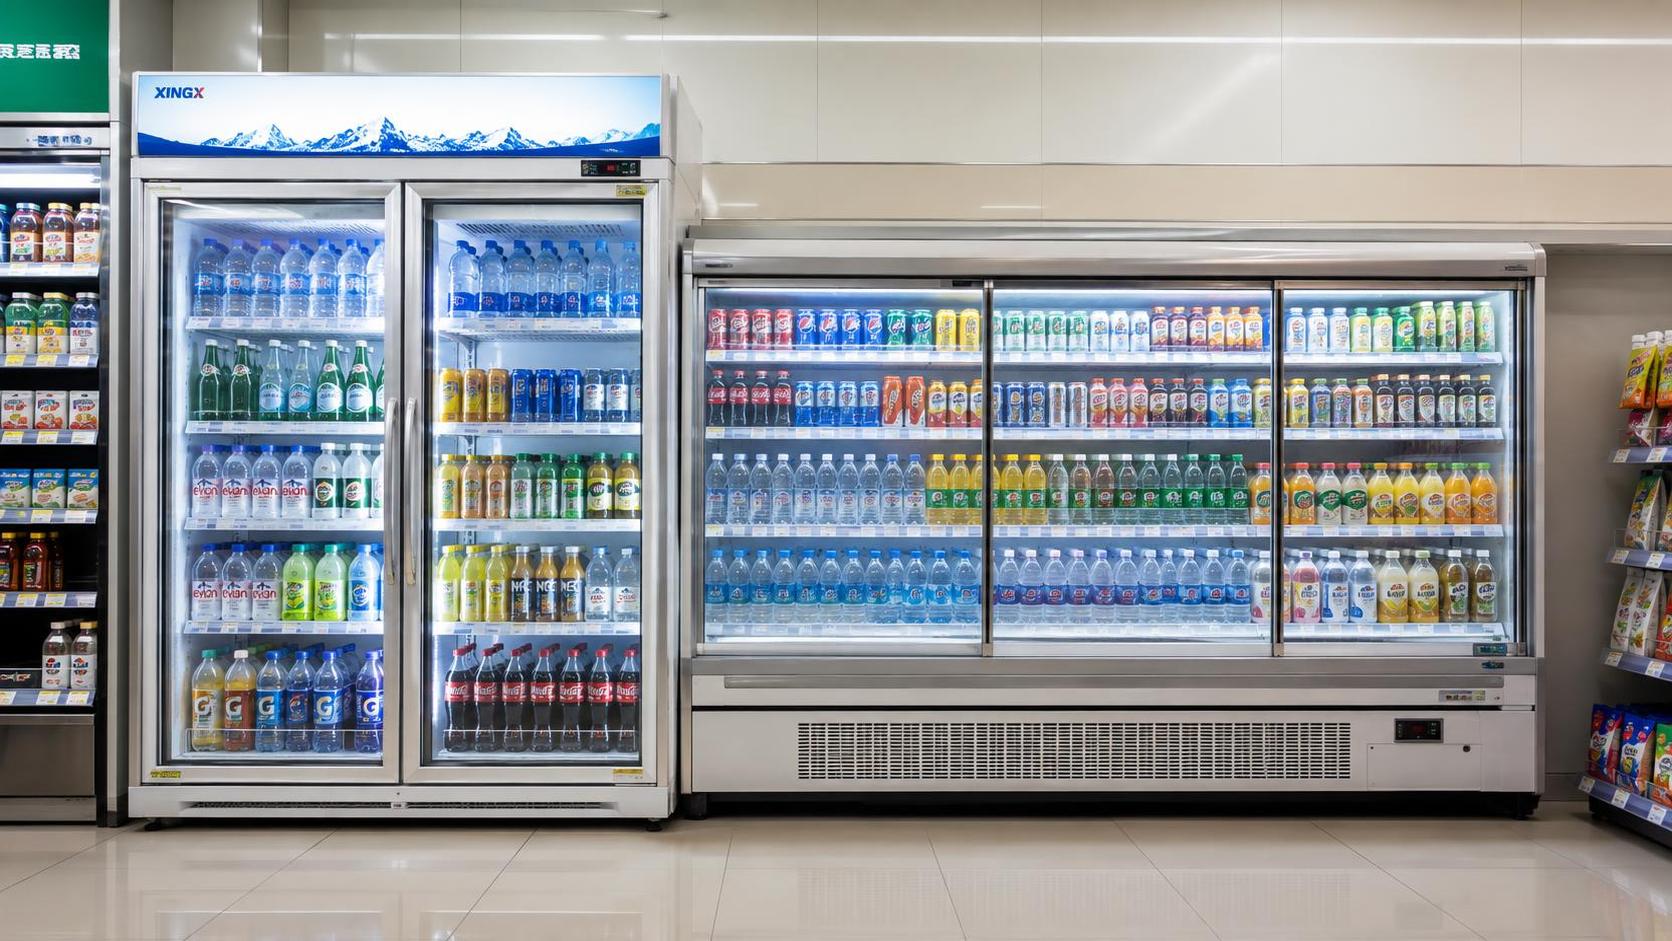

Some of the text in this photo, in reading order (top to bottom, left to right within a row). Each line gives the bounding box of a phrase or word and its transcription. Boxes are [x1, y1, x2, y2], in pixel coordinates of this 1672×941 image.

[154, 87, 205, 99] XINGX
[258, 696, 275, 715] G
[317, 696, 332, 716] G
